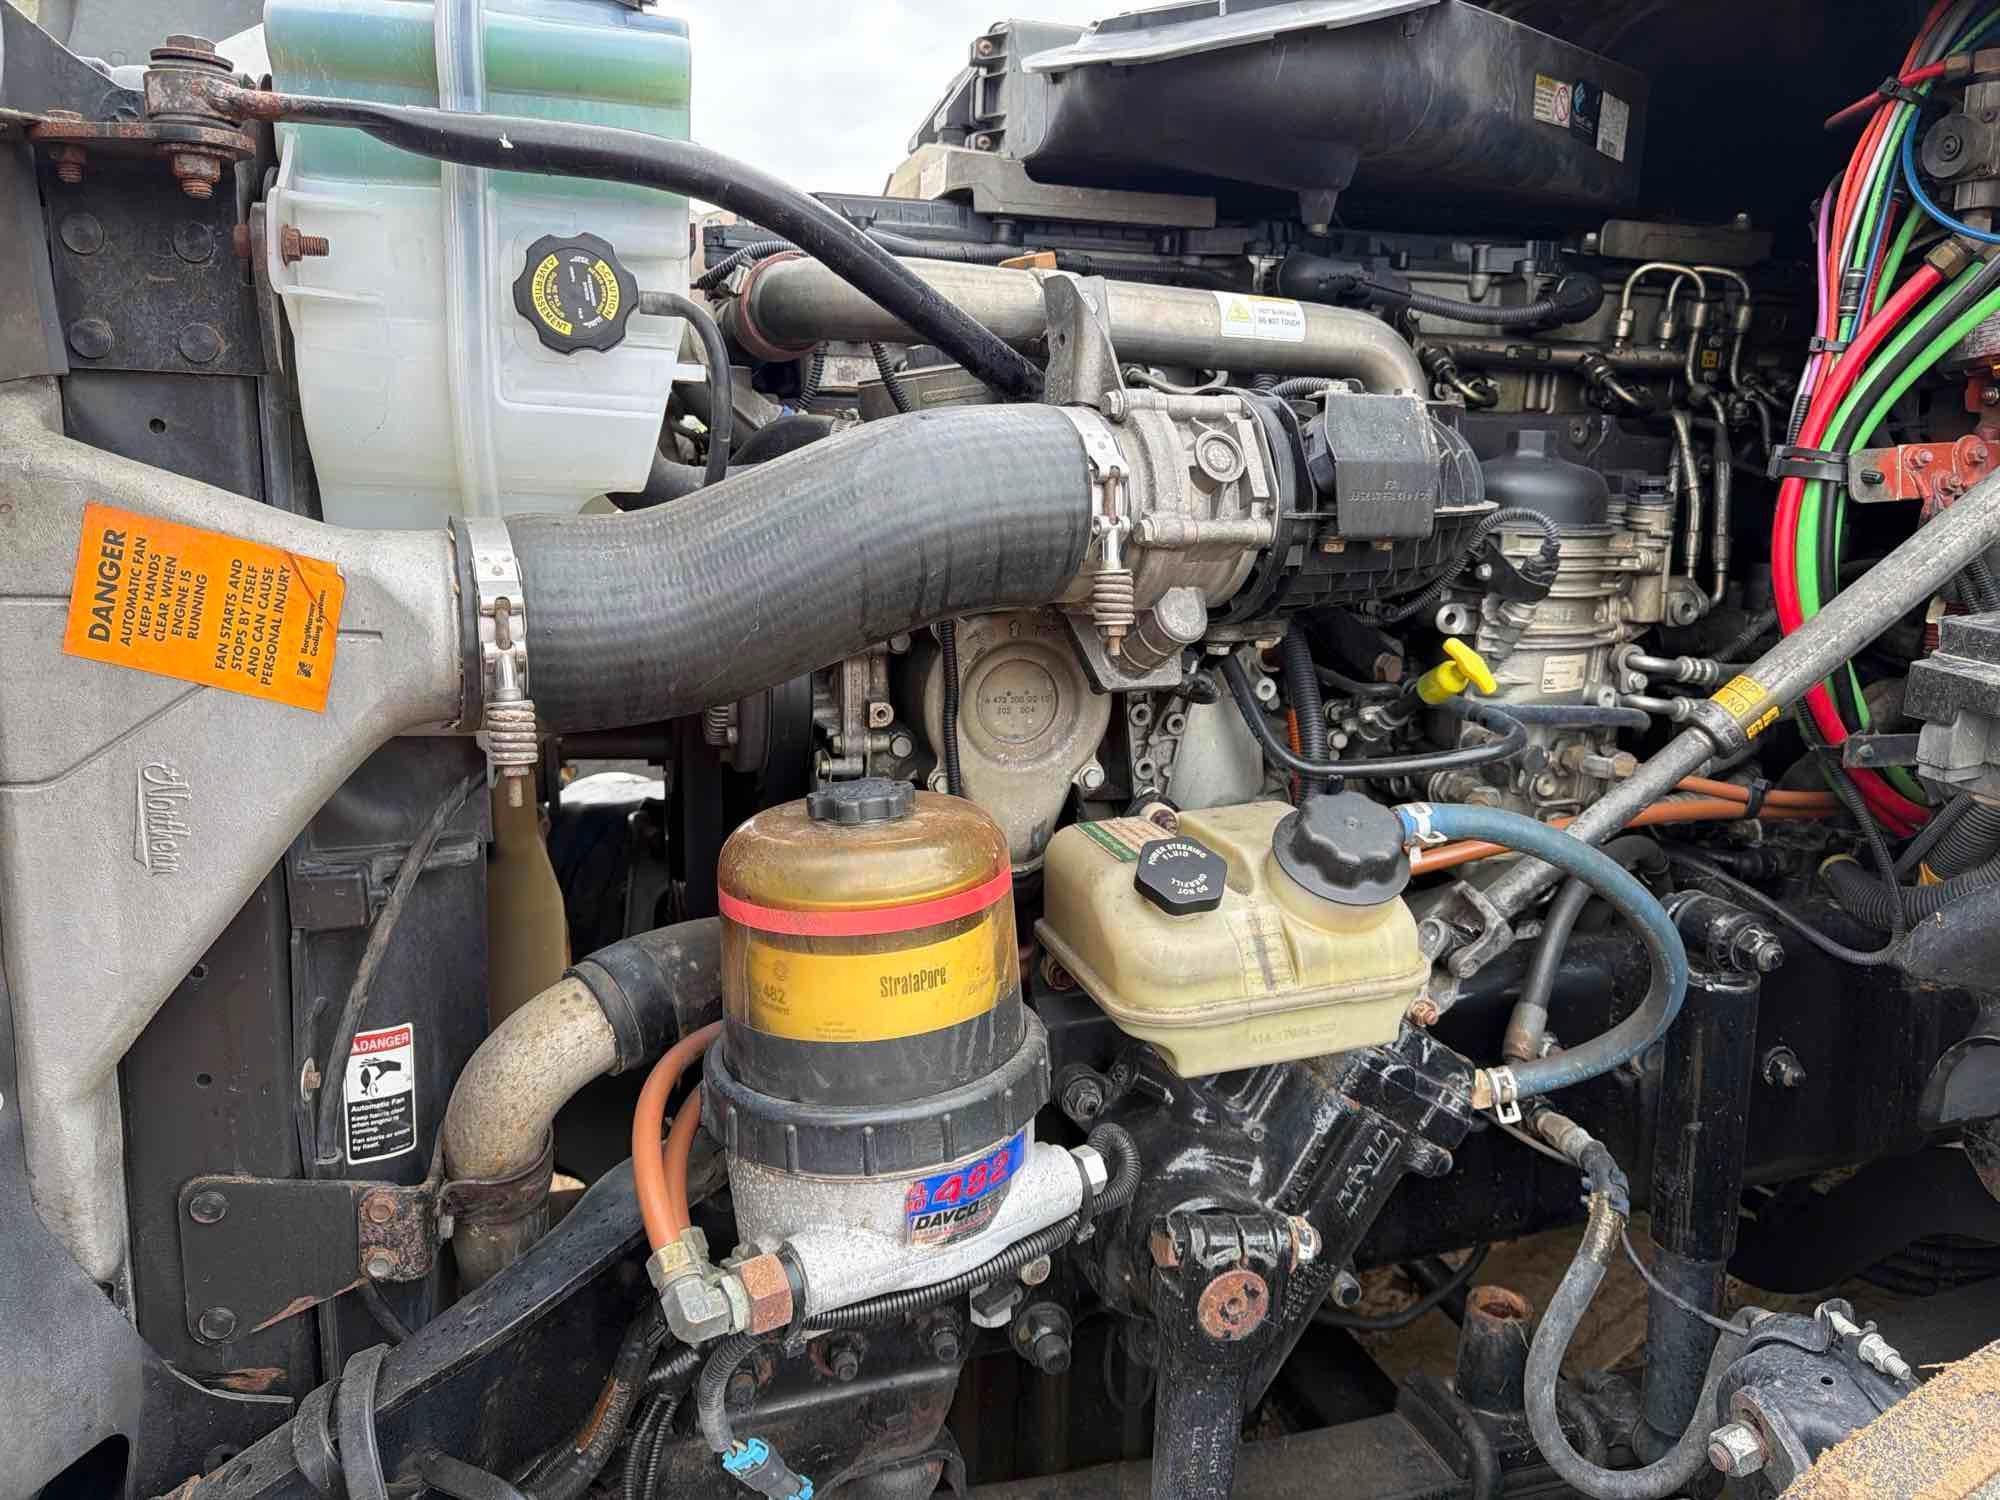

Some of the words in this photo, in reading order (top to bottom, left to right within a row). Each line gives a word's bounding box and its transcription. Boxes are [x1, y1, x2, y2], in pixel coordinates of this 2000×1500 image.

[535, 262, 568, 331] AVERTISSEMENT
[604, 271, 616, 316] CAUTION
[88, 529, 127, 644] DANGER
[120, 562, 144, 647] AUTOMATIC
[134, 537, 147, 559] FAN
[138, 602, 154, 638] KEEP
[146, 553, 162, 601] HANDS
[230, 558, 243, 593] AND
[242, 566, 258, 606] ITSELF
[258, 567, 275, 611] CAUSE
[154, 603, 170, 642] CLEAR
[162, 556, 178, 600] WHEN
[172, 584, 190, 637] ENGINE
[181, 569, 192, 581] IS
[188, 574, 208, 640] RUNNING
[219, 596, 237, 640] STARTS
[239, 609, 251, 628] BY
[252, 615, 266, 644] CAN
[260, 620, 281, 686] PERSONAL
[274, 564, 291, 617] INJURY
[216, 643, 228, 670] FAN
[231, 631, 246, 671] STOPS
[246, 648, 260, 677] AND
[880, 966, 946, 997] StrataPore
[360, 1032, 409, 1051] DANGER
[932, 1150, 1009, 1204] 482
[915, 1200, 979, 1230] DAVCO
